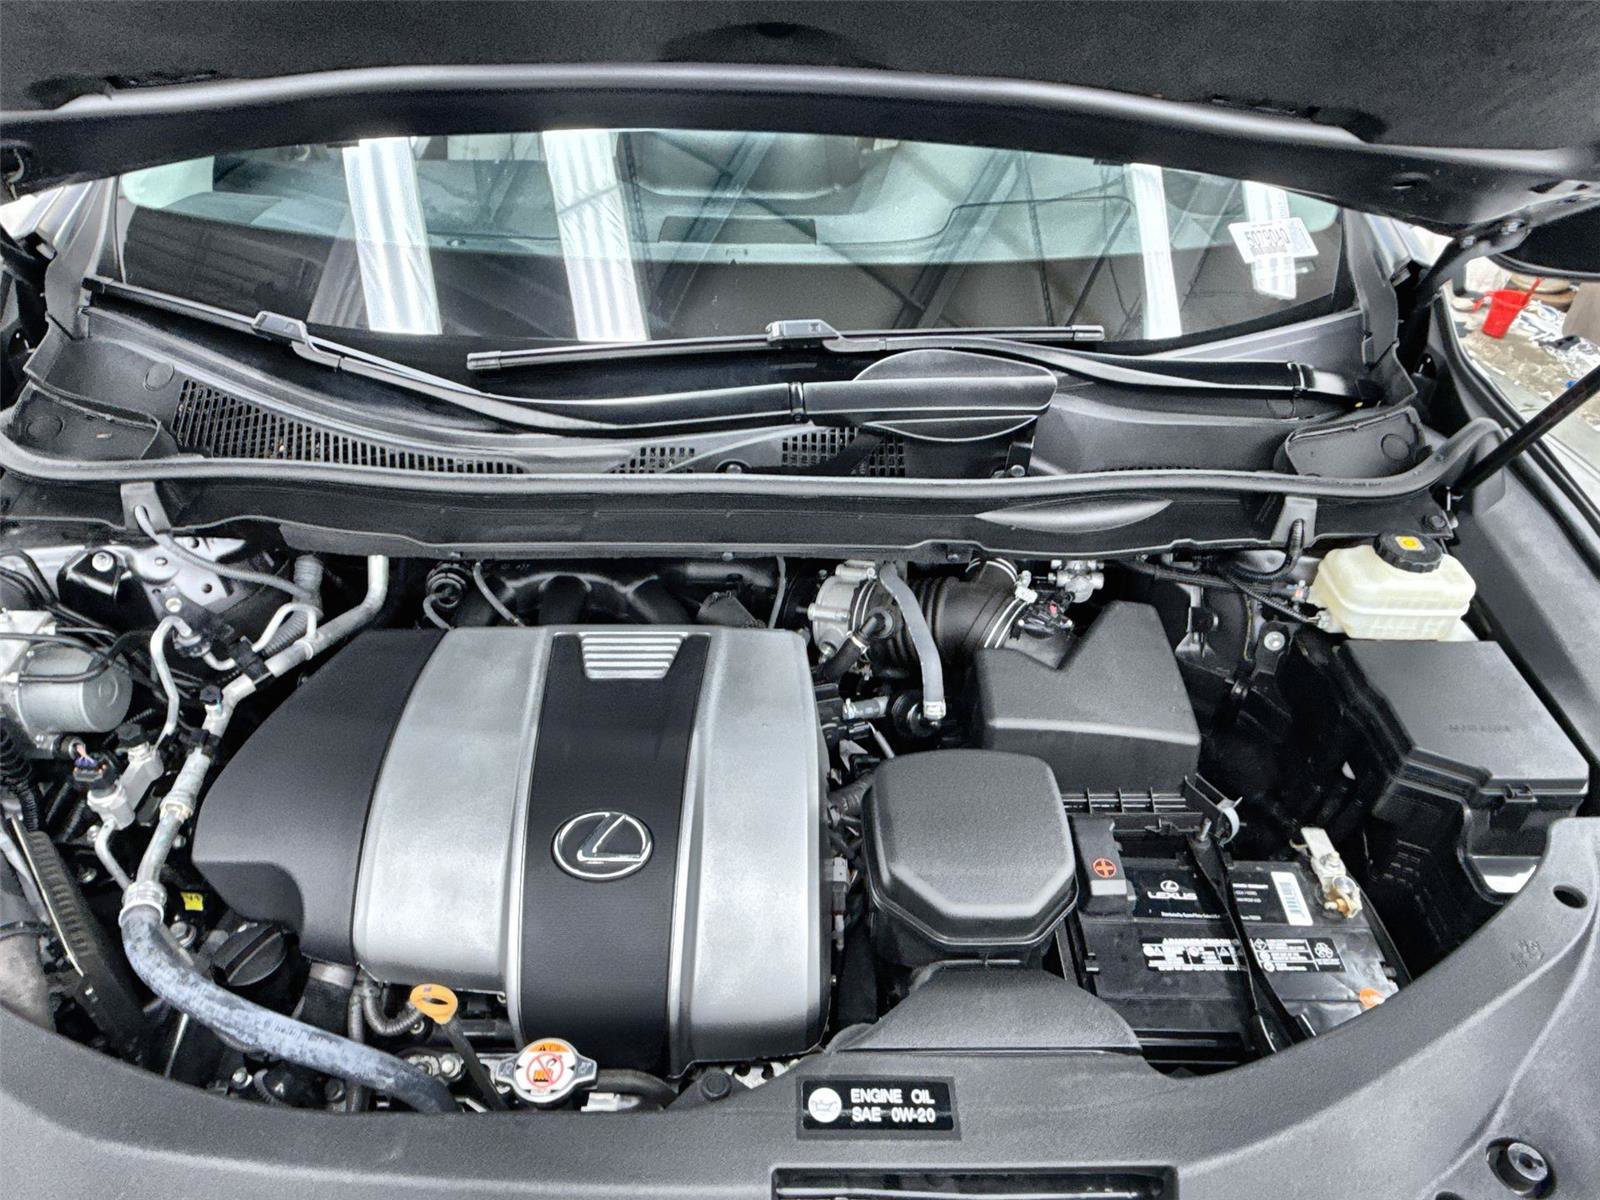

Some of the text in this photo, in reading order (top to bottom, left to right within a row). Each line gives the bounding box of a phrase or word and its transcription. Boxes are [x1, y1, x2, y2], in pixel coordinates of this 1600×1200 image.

[1147, 891, 1198, 900] LEXUS
[850, 1088, 935, 1104] ENGINE OIL
[851, 1106, 936, 1123] SAE 0W-20
